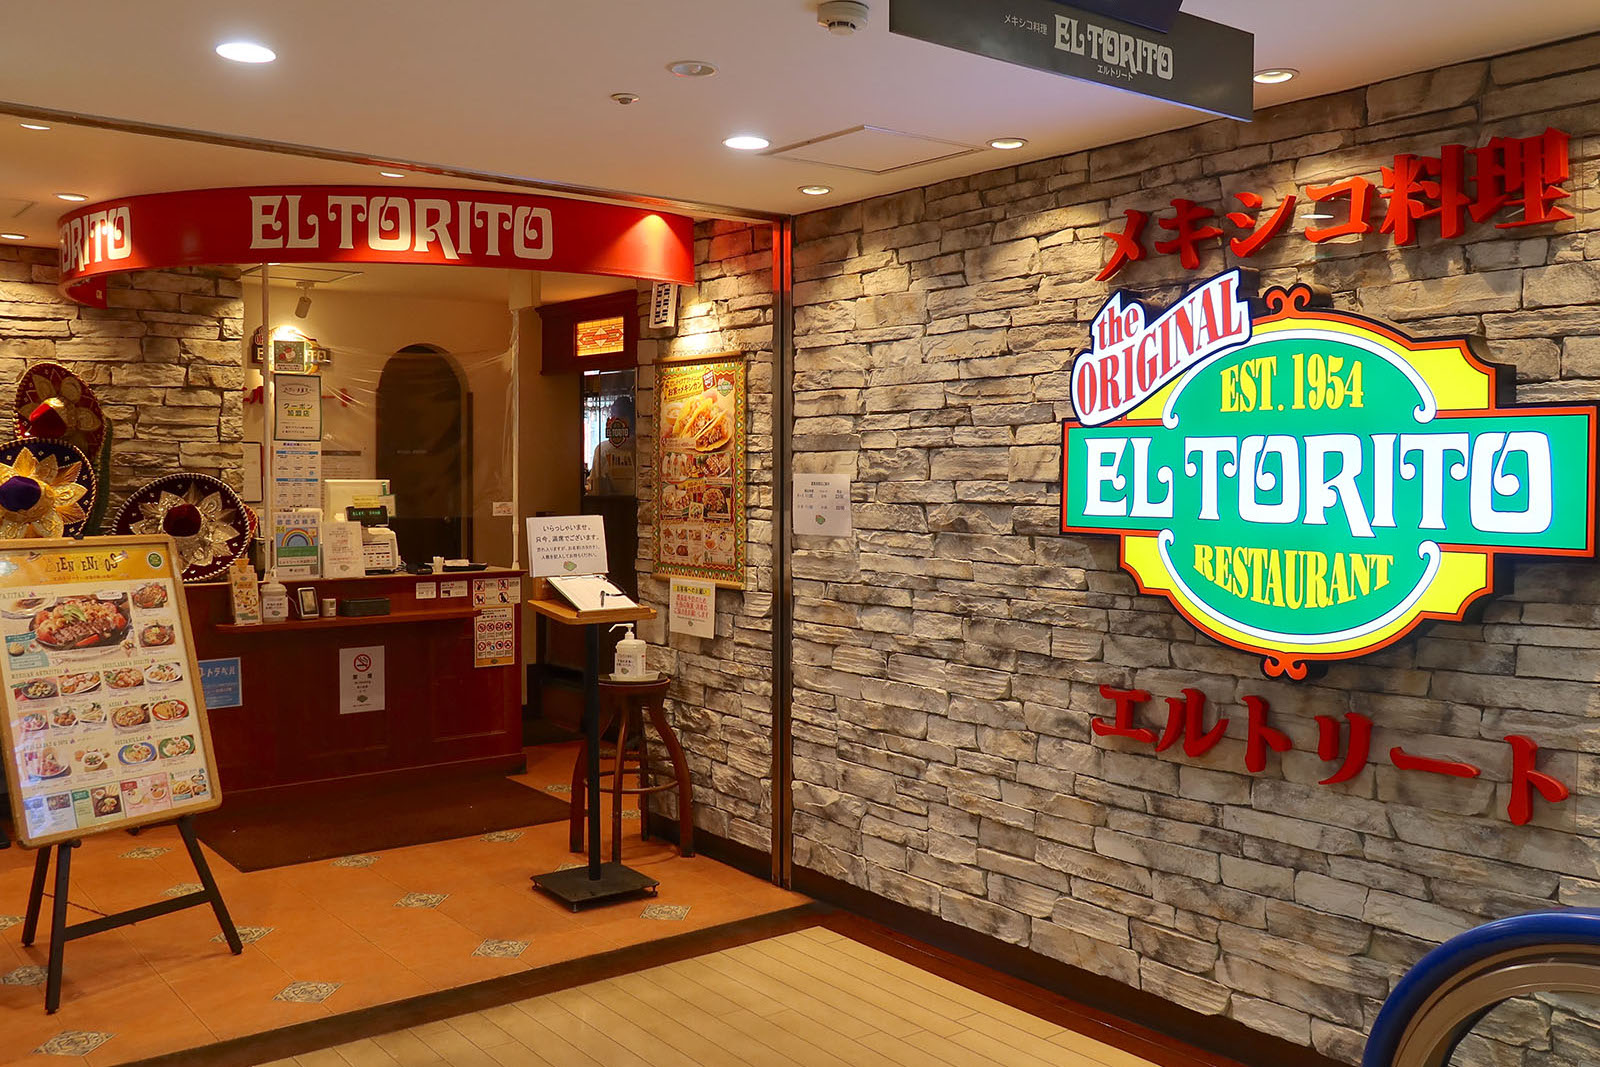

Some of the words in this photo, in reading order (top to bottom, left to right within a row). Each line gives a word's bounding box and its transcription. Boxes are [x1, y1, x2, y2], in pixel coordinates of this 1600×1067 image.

[1004, 14, 1048, 35] メキシコ料理
[1054, 14, 1085, 56] EL
[1088, 24, 1173, 80] TORITO
[1097, 64, 1133, 81] エルトリート
[249, 195, 319, 249] EL
[327, 195, 553, 260] TORITO
[1095, 127, 1575, 281] メキシコ料理
[1077, 270, 1245, 415] ORIGINAL
[1098, 304, 1140, 350] the
[1219, 356, 1283, 413] EST.
[1291, 353, 1364, 410] 1954
[1082, 437, 1174, 518] EL
[1184, 431, 1552, 538] TORITO
[1194, 544, 1395, 609] RESTAURANT
[1092, 684, 1570, 826] エルトリート
